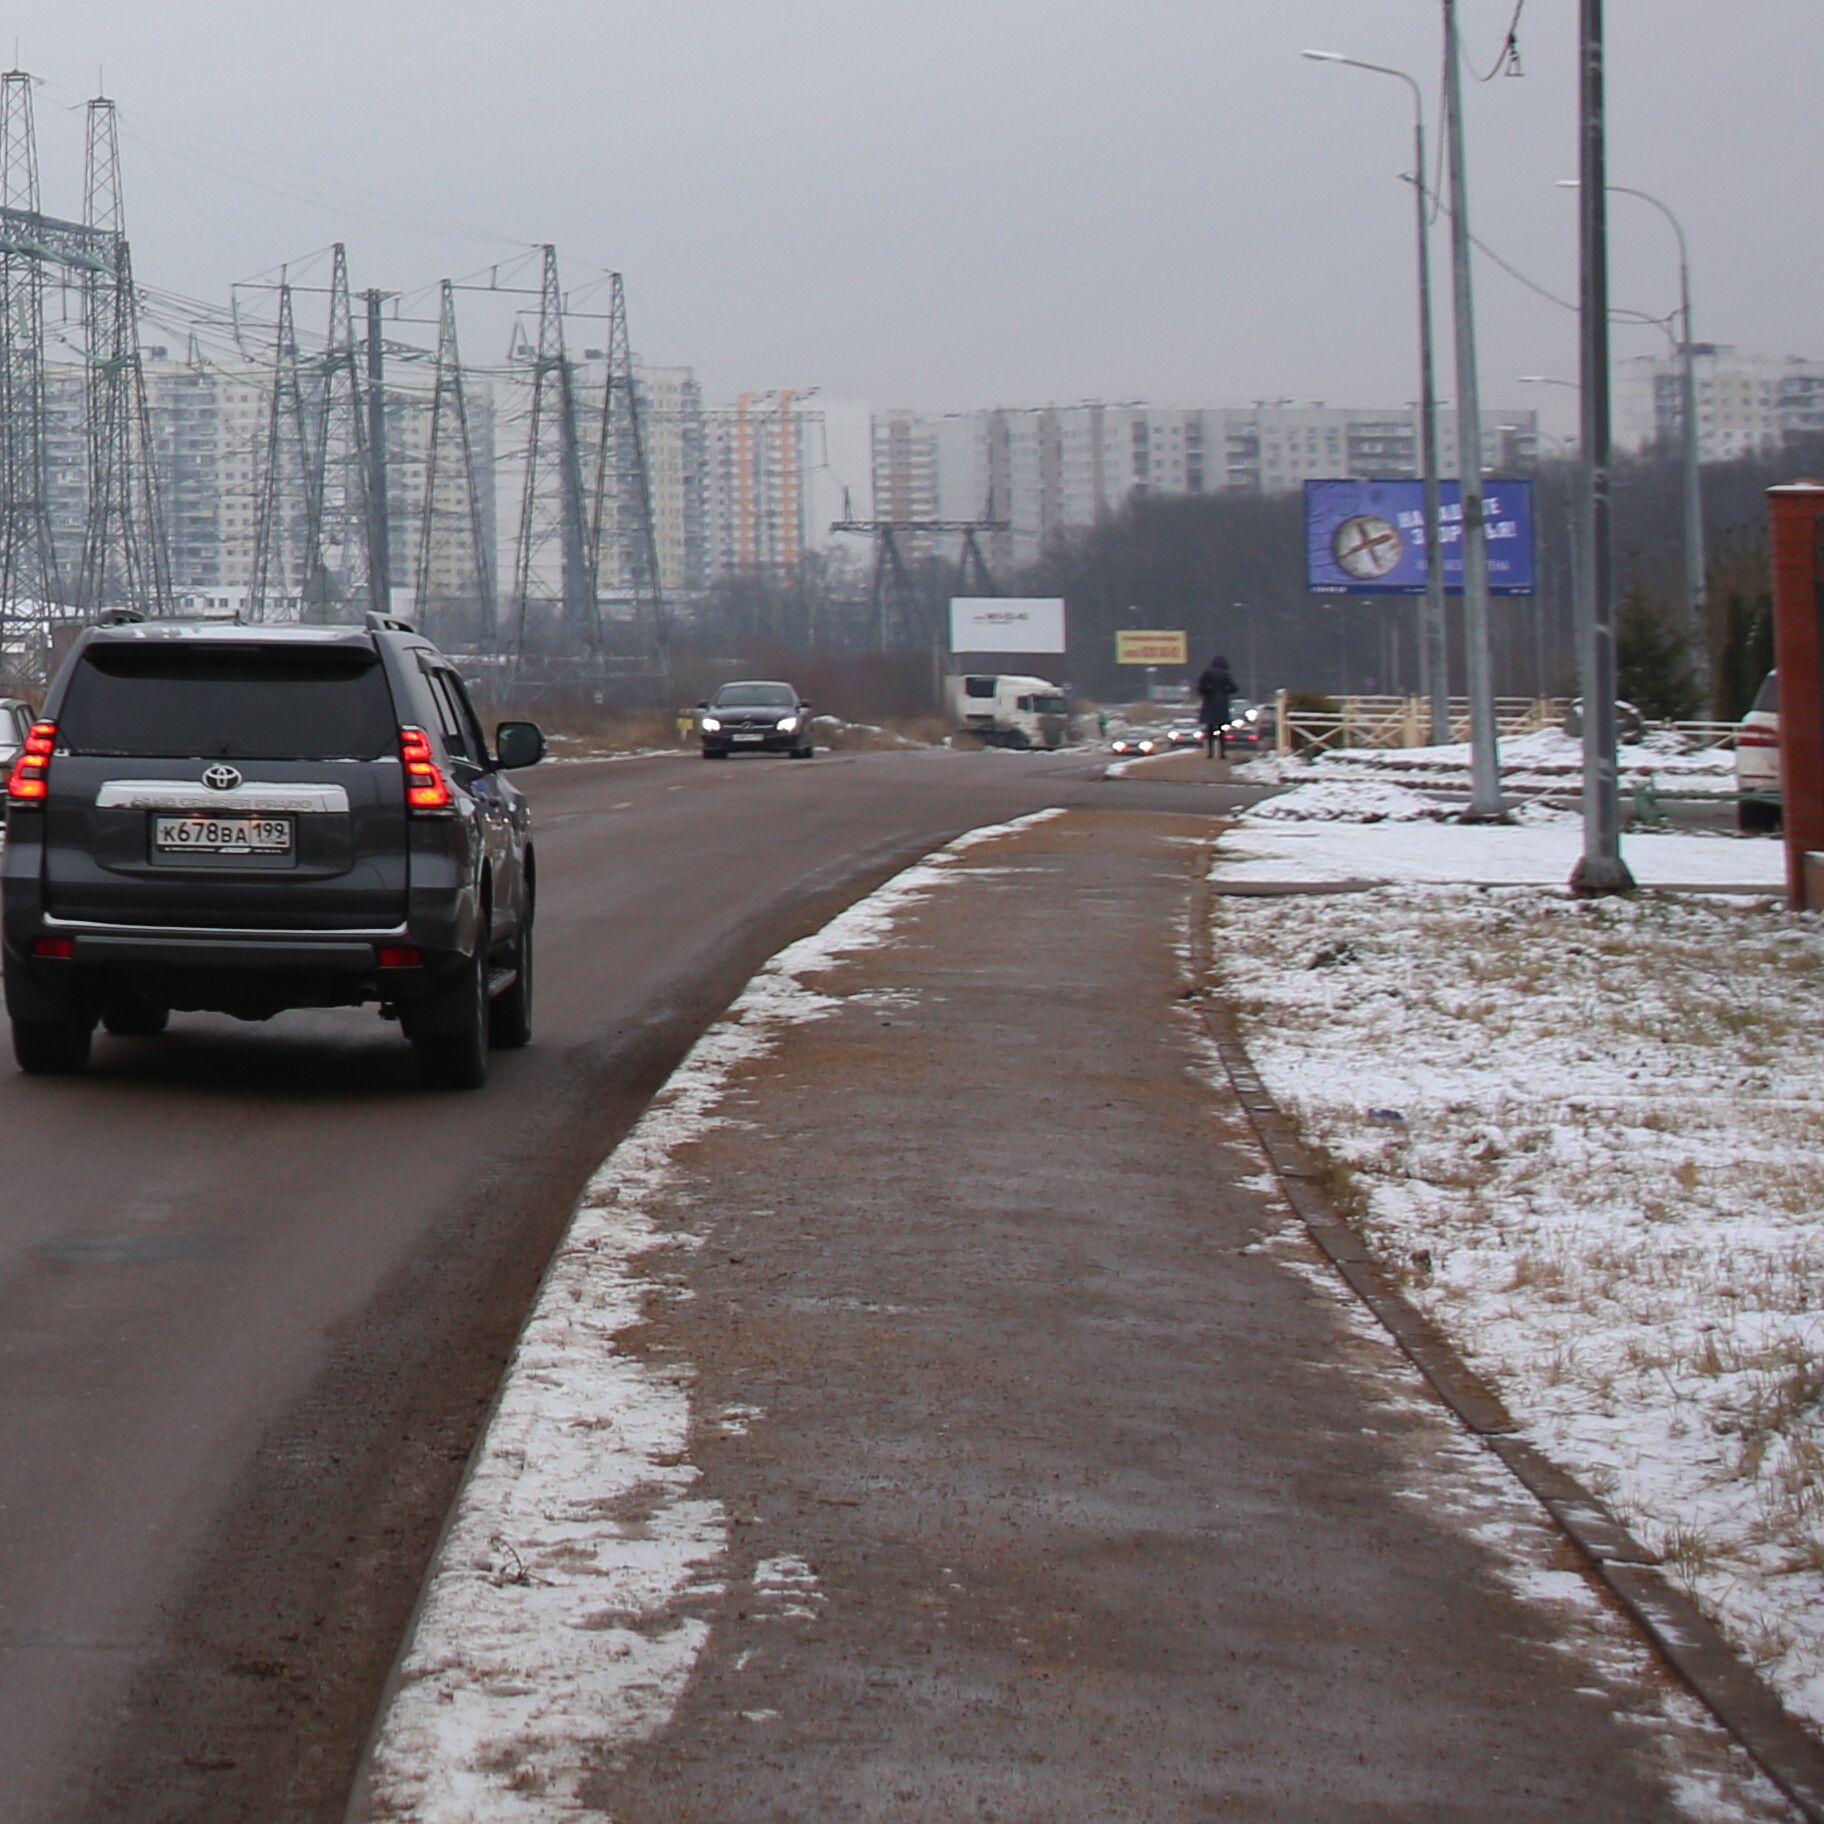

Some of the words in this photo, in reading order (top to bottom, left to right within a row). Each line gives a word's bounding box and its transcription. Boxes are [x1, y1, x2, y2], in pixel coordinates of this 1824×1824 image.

[254, 799, 312, 810] PRADO
[163, 821, 248, 844] К678ВА
[253, 822, 285, 839] 199
